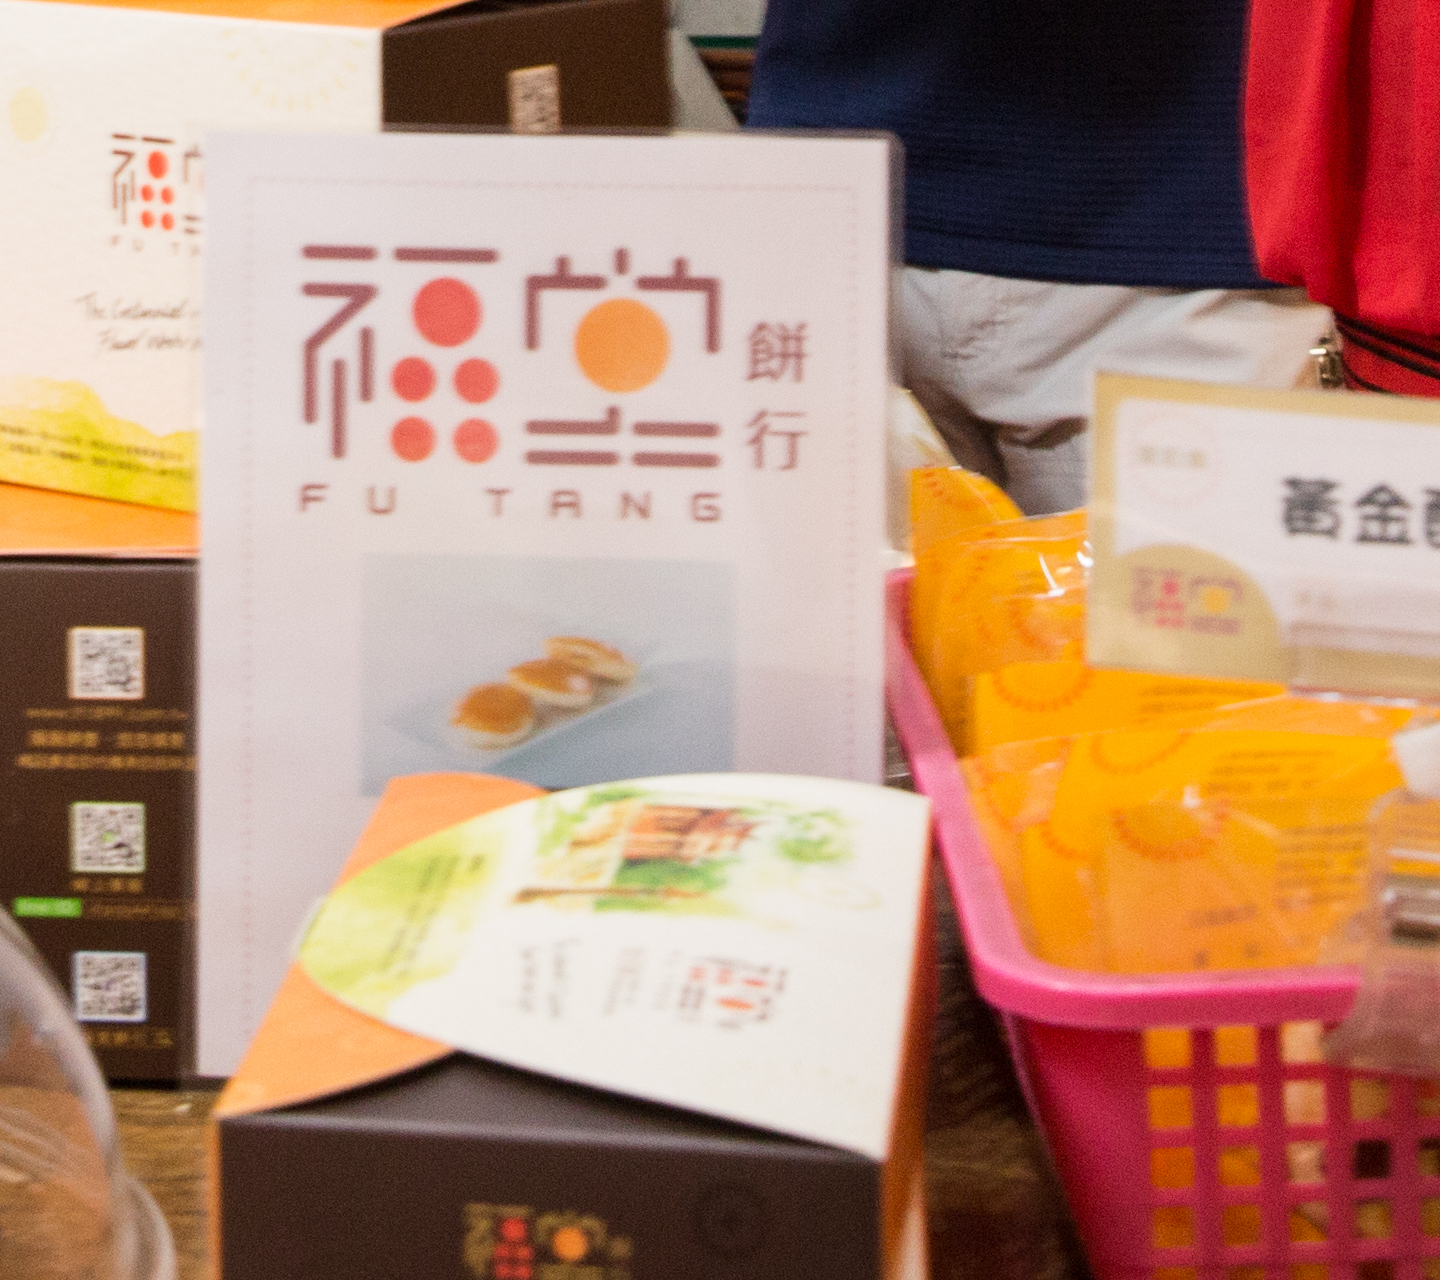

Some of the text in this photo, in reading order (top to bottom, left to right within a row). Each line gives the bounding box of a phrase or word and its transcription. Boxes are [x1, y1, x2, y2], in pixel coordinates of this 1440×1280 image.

[745, 320, 809, 473] 餅行
[299, 482, 723, 523] FU TANG
